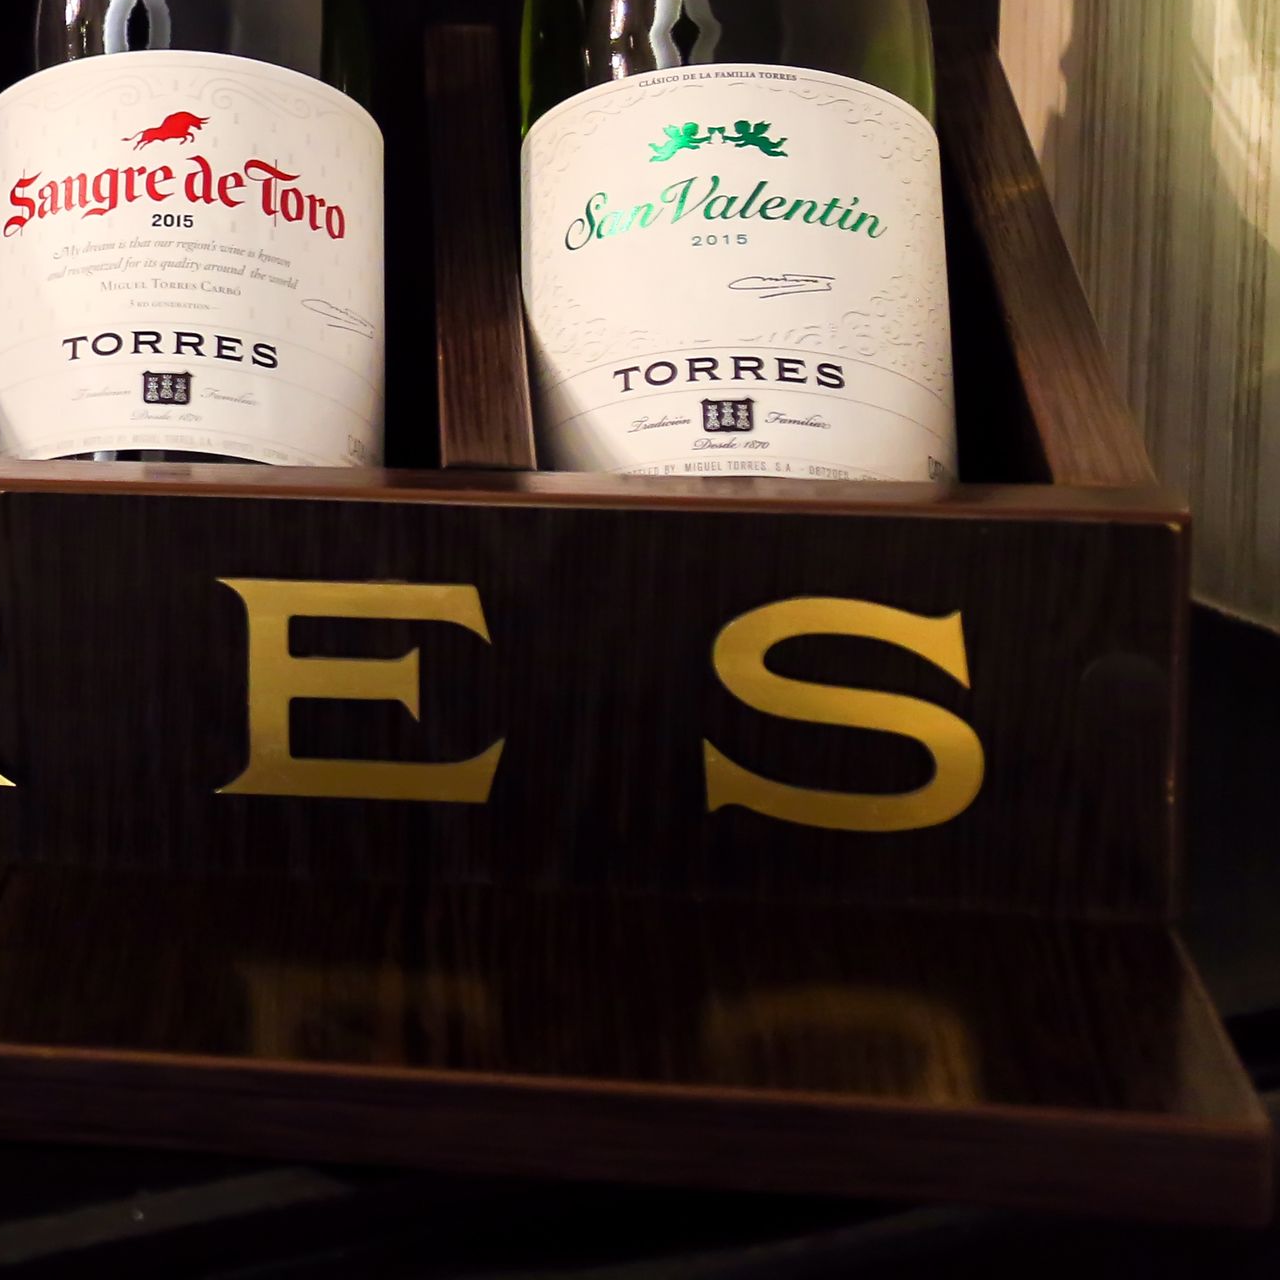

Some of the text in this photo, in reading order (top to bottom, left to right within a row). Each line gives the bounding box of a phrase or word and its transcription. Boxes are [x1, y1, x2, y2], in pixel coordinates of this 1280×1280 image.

[638, 74, 679, 87] CLÁSICO
[715, 71, 756, 79] FAMILIA
[759, 72, 797, 81] TORRES
[3, 155, 345, 240] Sangre de Toro
[151, 214, 194, 229] 2015
[564, 191, 662, 250] San
[118, 240, 126, 249] is
[128, 237, 151, 249] that
[154, 240, 173, 248] our
[175, 239, 216, 253] region's
[219, 243, 246, 256] wine
[691, 233, 748, 247] 2015
[122, 257, 141, 272] for
[144, 257, 157, 268] its
[160, 257, 202, 272] quality
[204, 262, 245, 276] around
[249, 266, 267, 281] the
[62, 330, 279, 369] TORRES
[613, 355, 845, 393] TORRES
[627, 411, 831, 433] Tradición Familiar
[691, 437, 770, 450] Desde 1870
[684, 461, 722, 472] MIGUEL
[727, 461, 767, 471] TORRES
